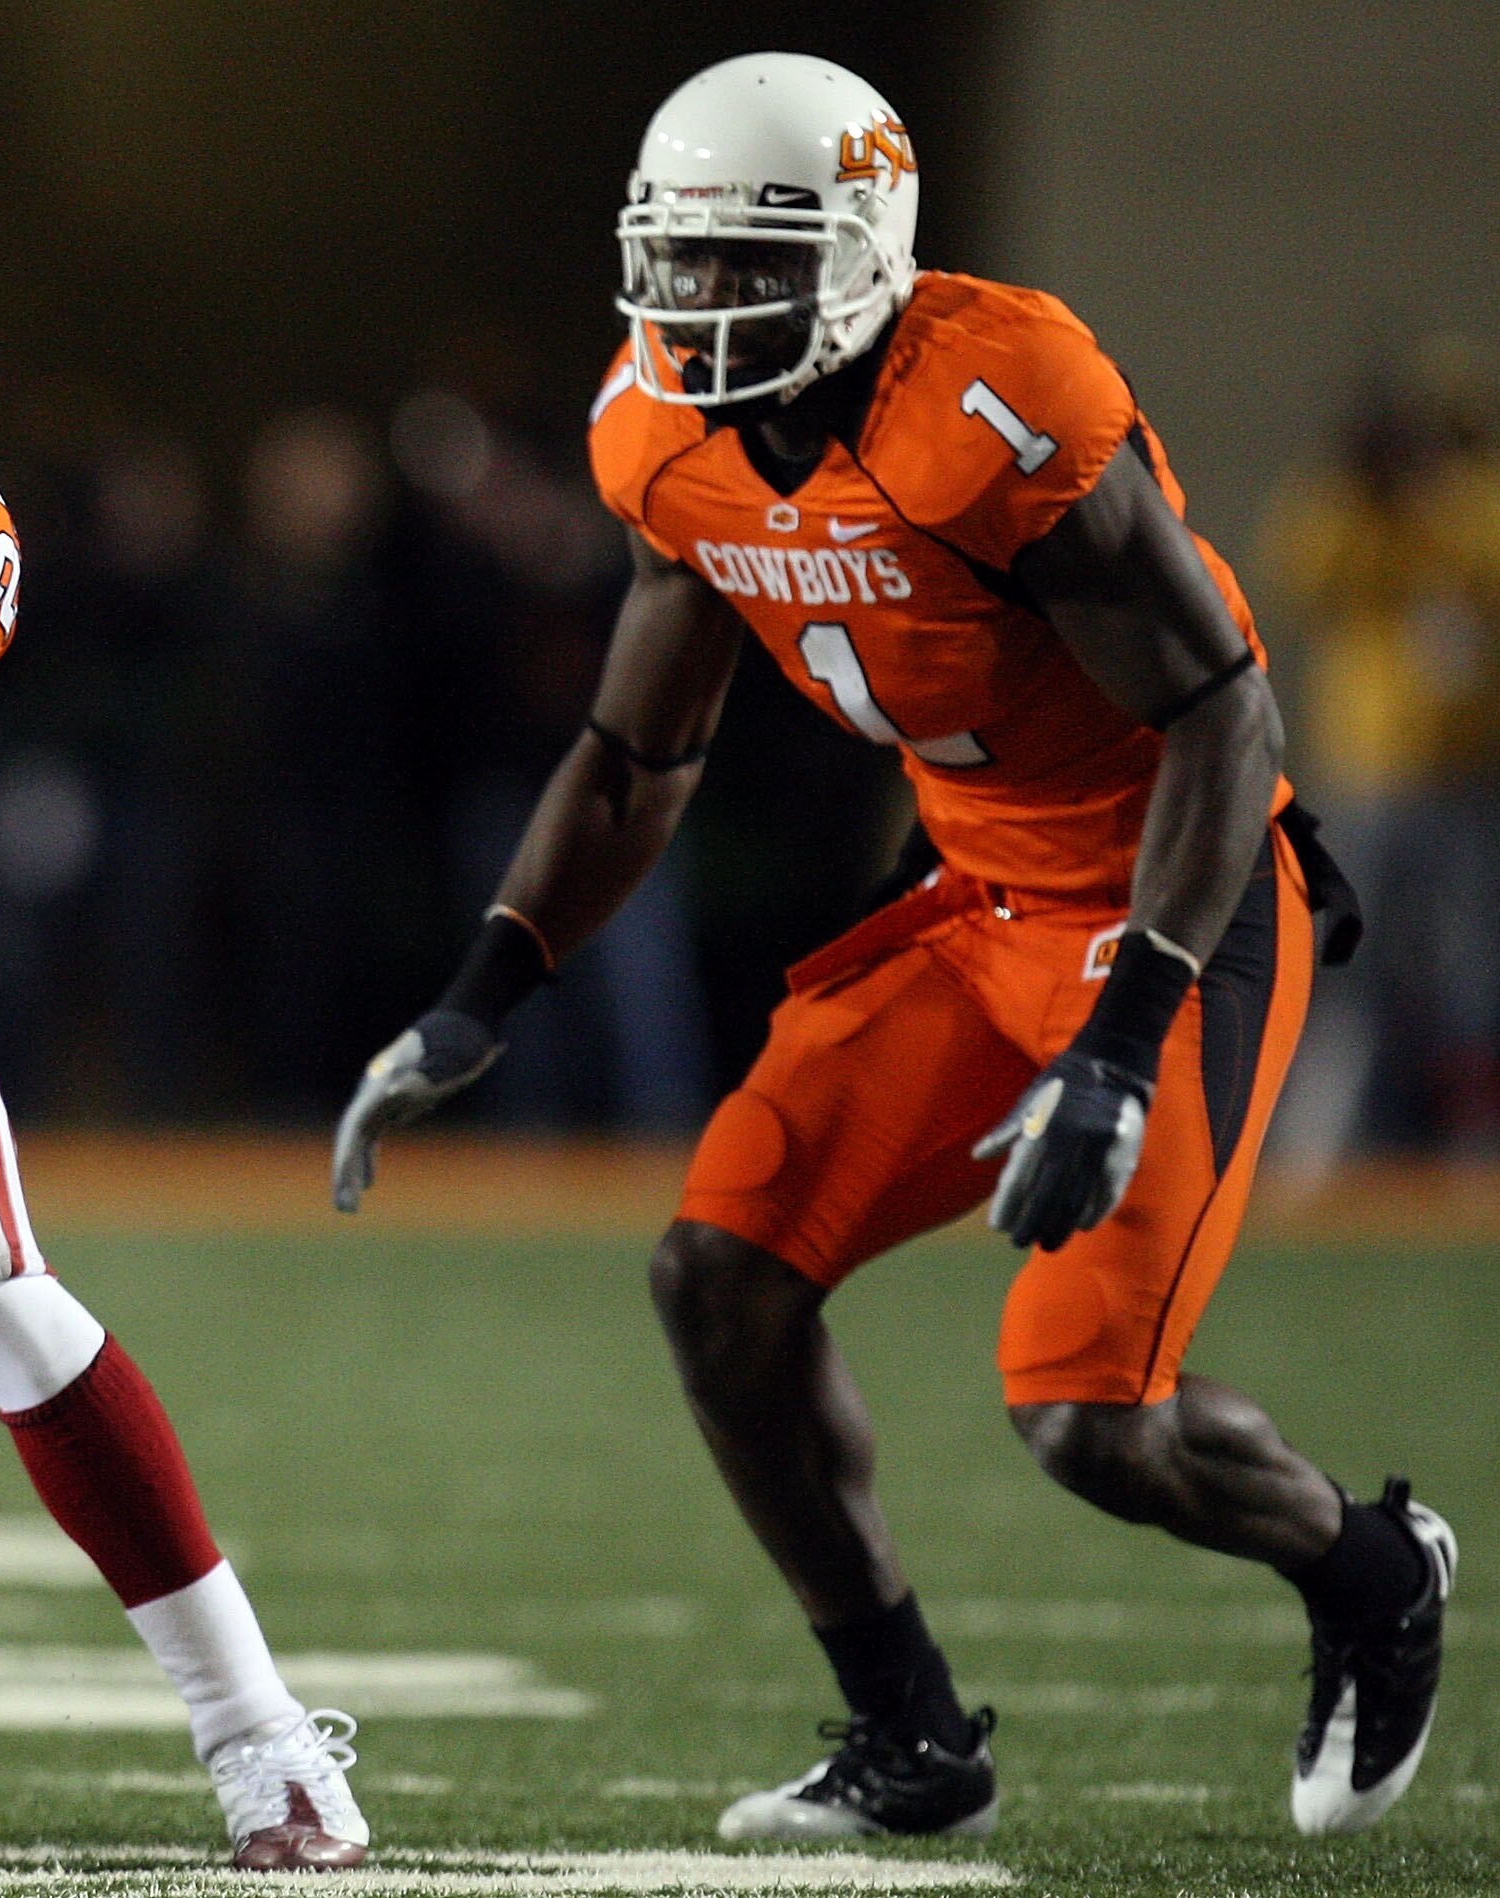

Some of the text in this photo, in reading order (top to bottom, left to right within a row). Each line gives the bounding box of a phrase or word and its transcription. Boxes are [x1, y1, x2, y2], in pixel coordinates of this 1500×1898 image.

[960, 377, 1059, 478] 1
[695, 539, 913, 605] COWBOYS
[796, 620, 995, 768] 1
